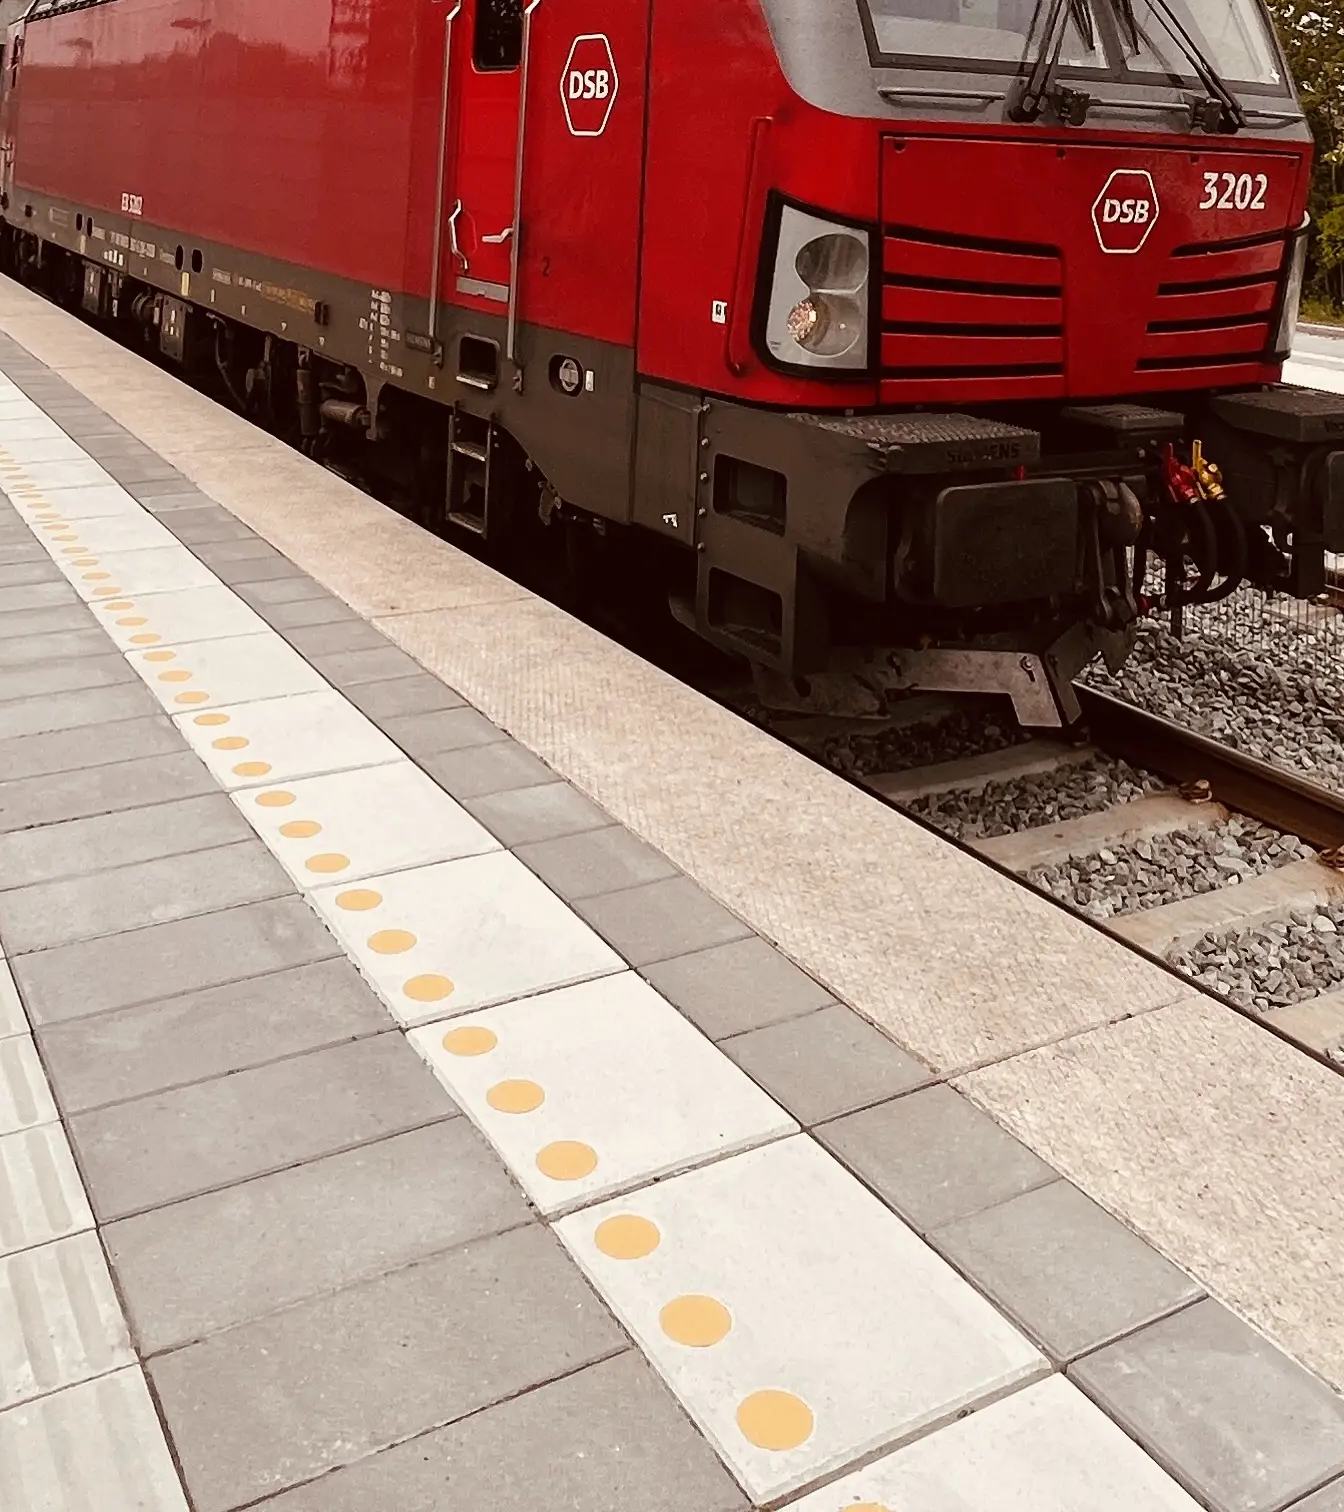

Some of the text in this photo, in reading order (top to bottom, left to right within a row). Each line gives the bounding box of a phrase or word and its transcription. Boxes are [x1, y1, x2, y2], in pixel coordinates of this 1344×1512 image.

[569, 70, 609, 99] DSB
[1199, 172, 1268, 210] 3202
[1103, 199, 1150, 223] DSB
